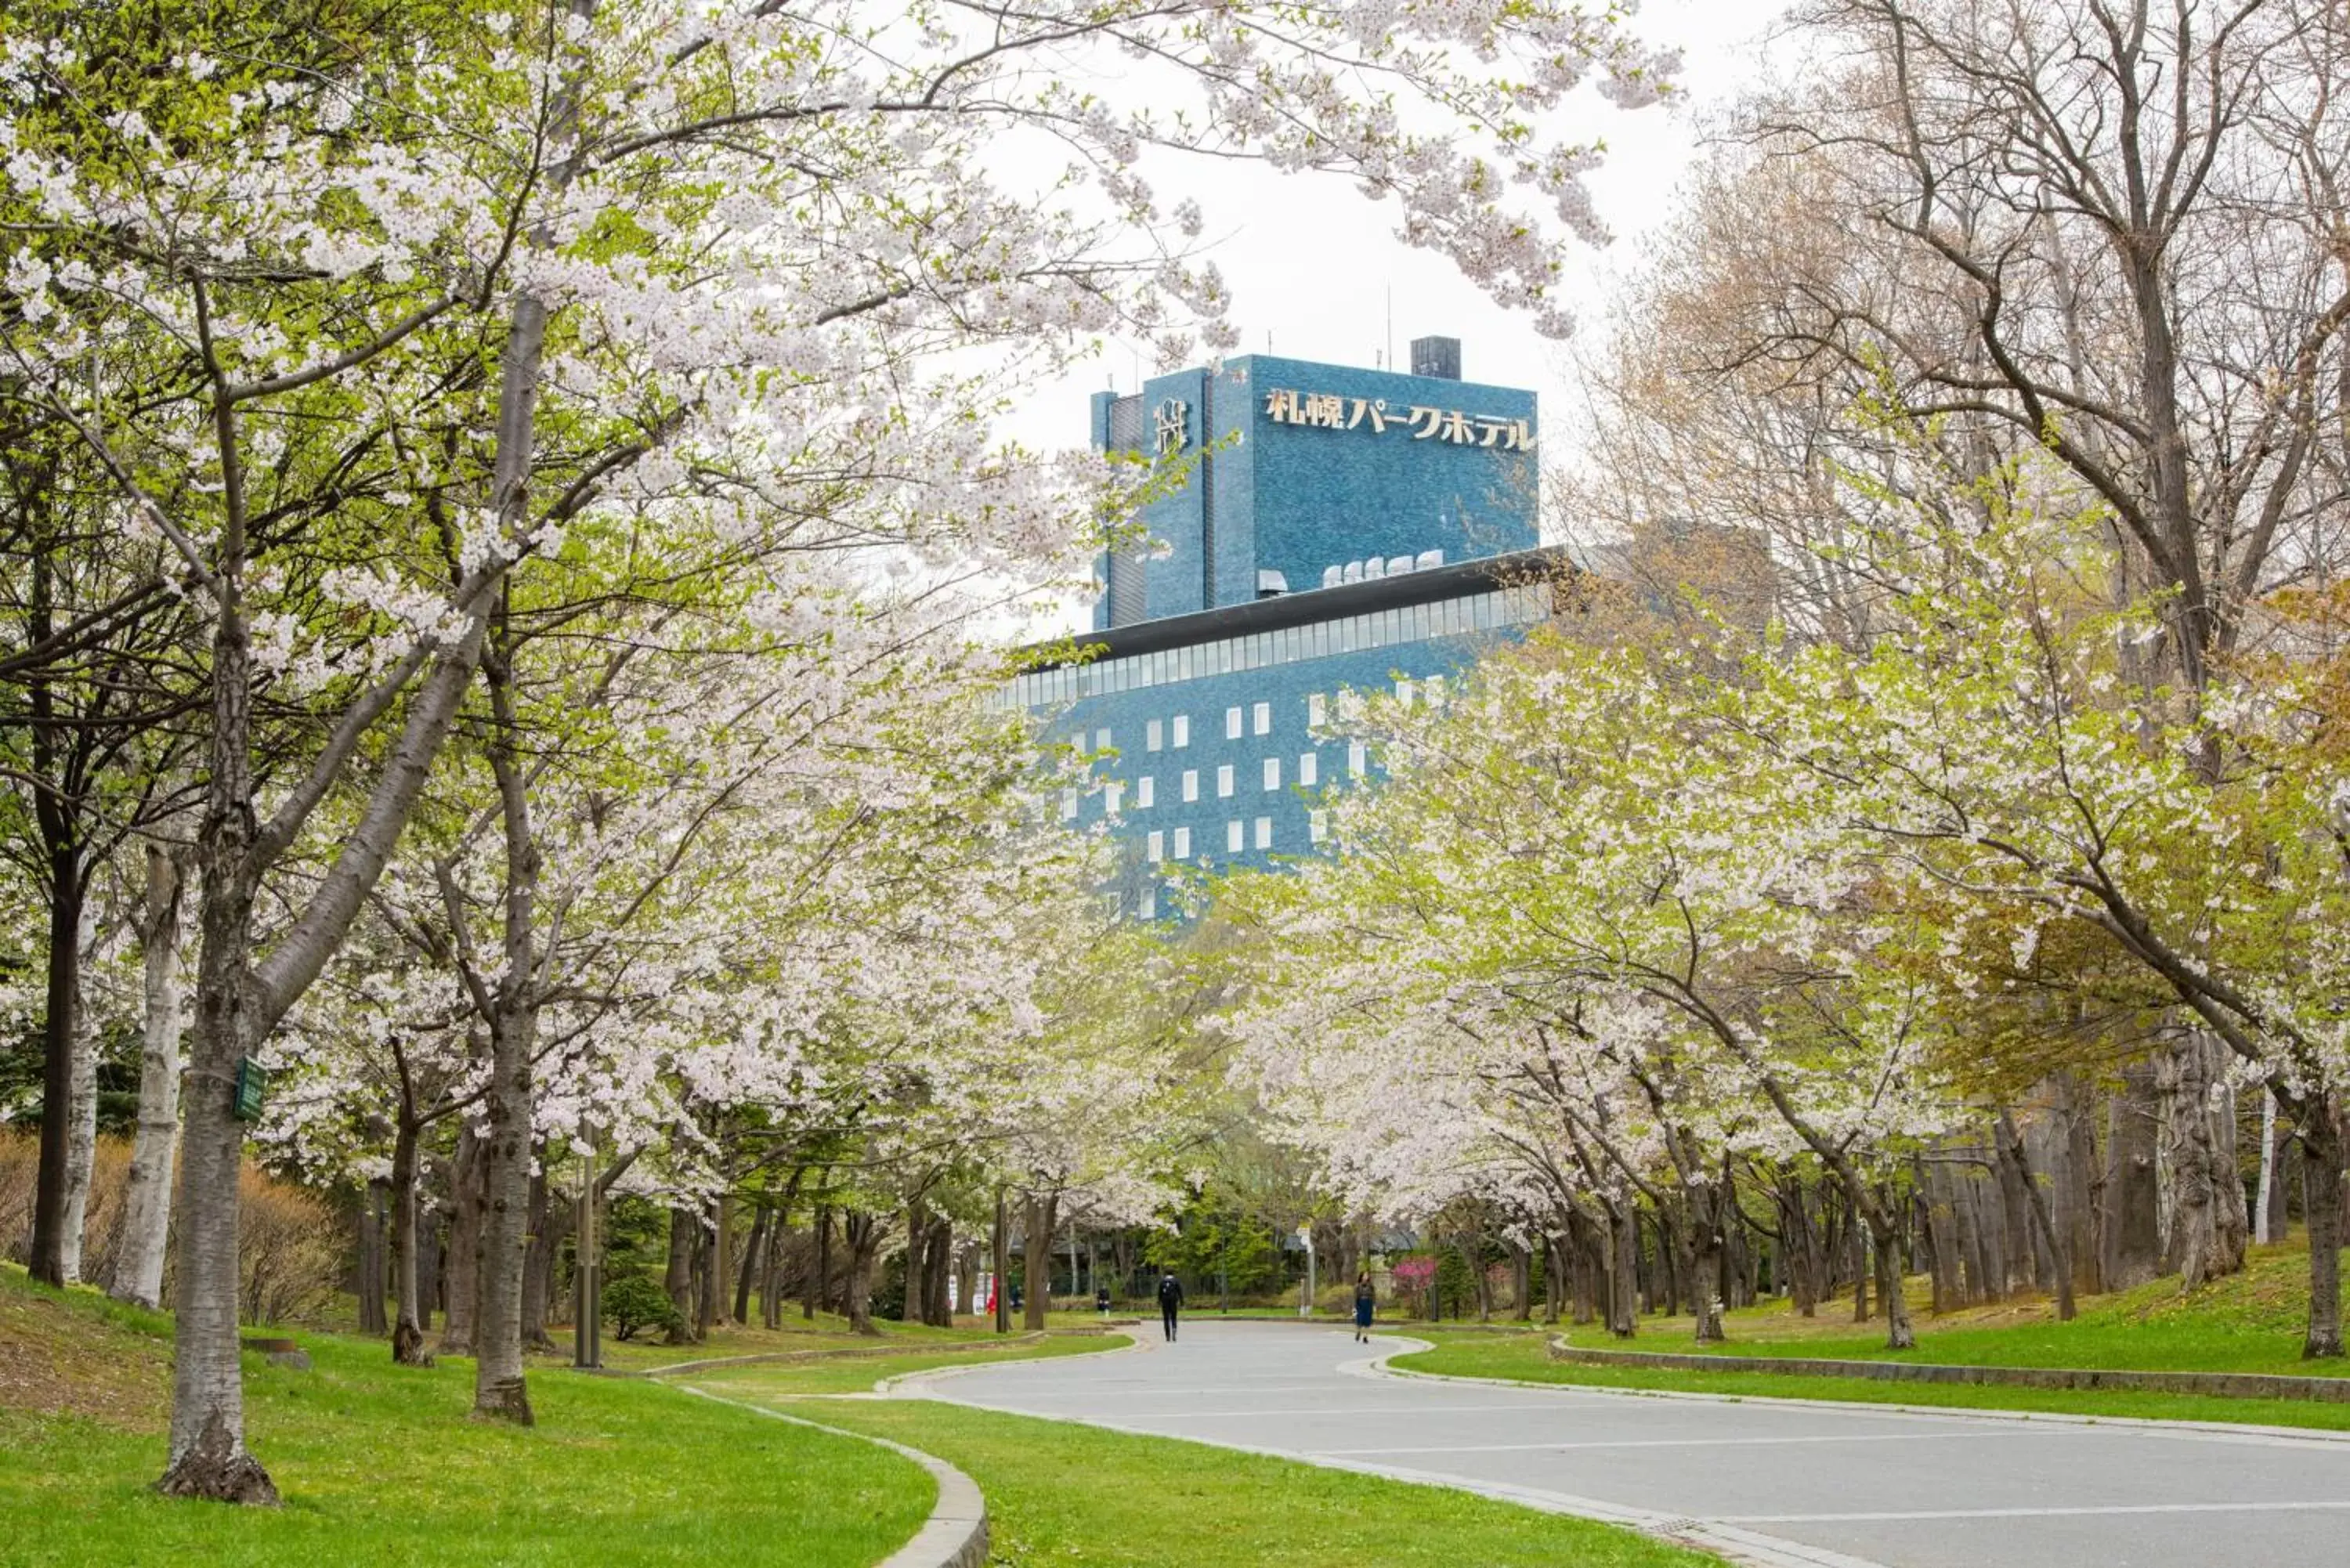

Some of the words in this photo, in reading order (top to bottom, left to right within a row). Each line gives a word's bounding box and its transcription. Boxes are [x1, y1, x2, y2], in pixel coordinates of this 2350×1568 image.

[1266, 388, 1537, 452] 札幌パークホテル
